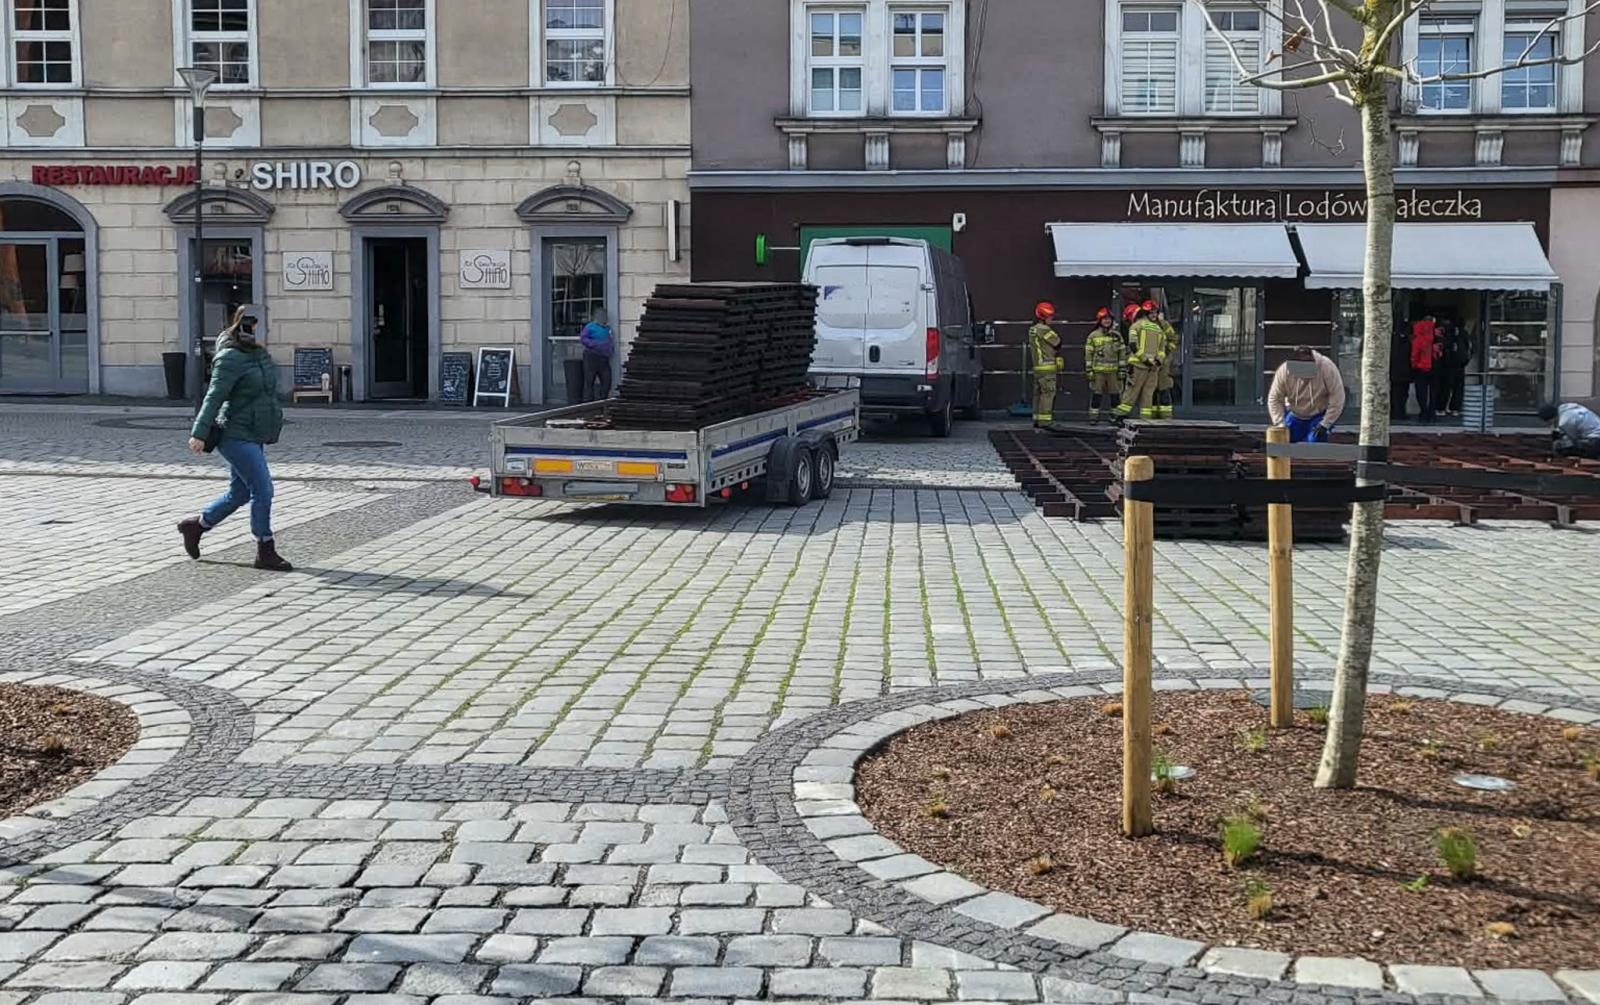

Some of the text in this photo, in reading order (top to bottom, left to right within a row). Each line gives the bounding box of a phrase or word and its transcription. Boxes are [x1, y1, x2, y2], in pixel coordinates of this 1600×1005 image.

[31, 165, 197, 186] RESTAURACJA
[251, 160, 361, 190] SHIRO
[1127, 188, 1482, 219] Manufaktura Lodów ałeczka
